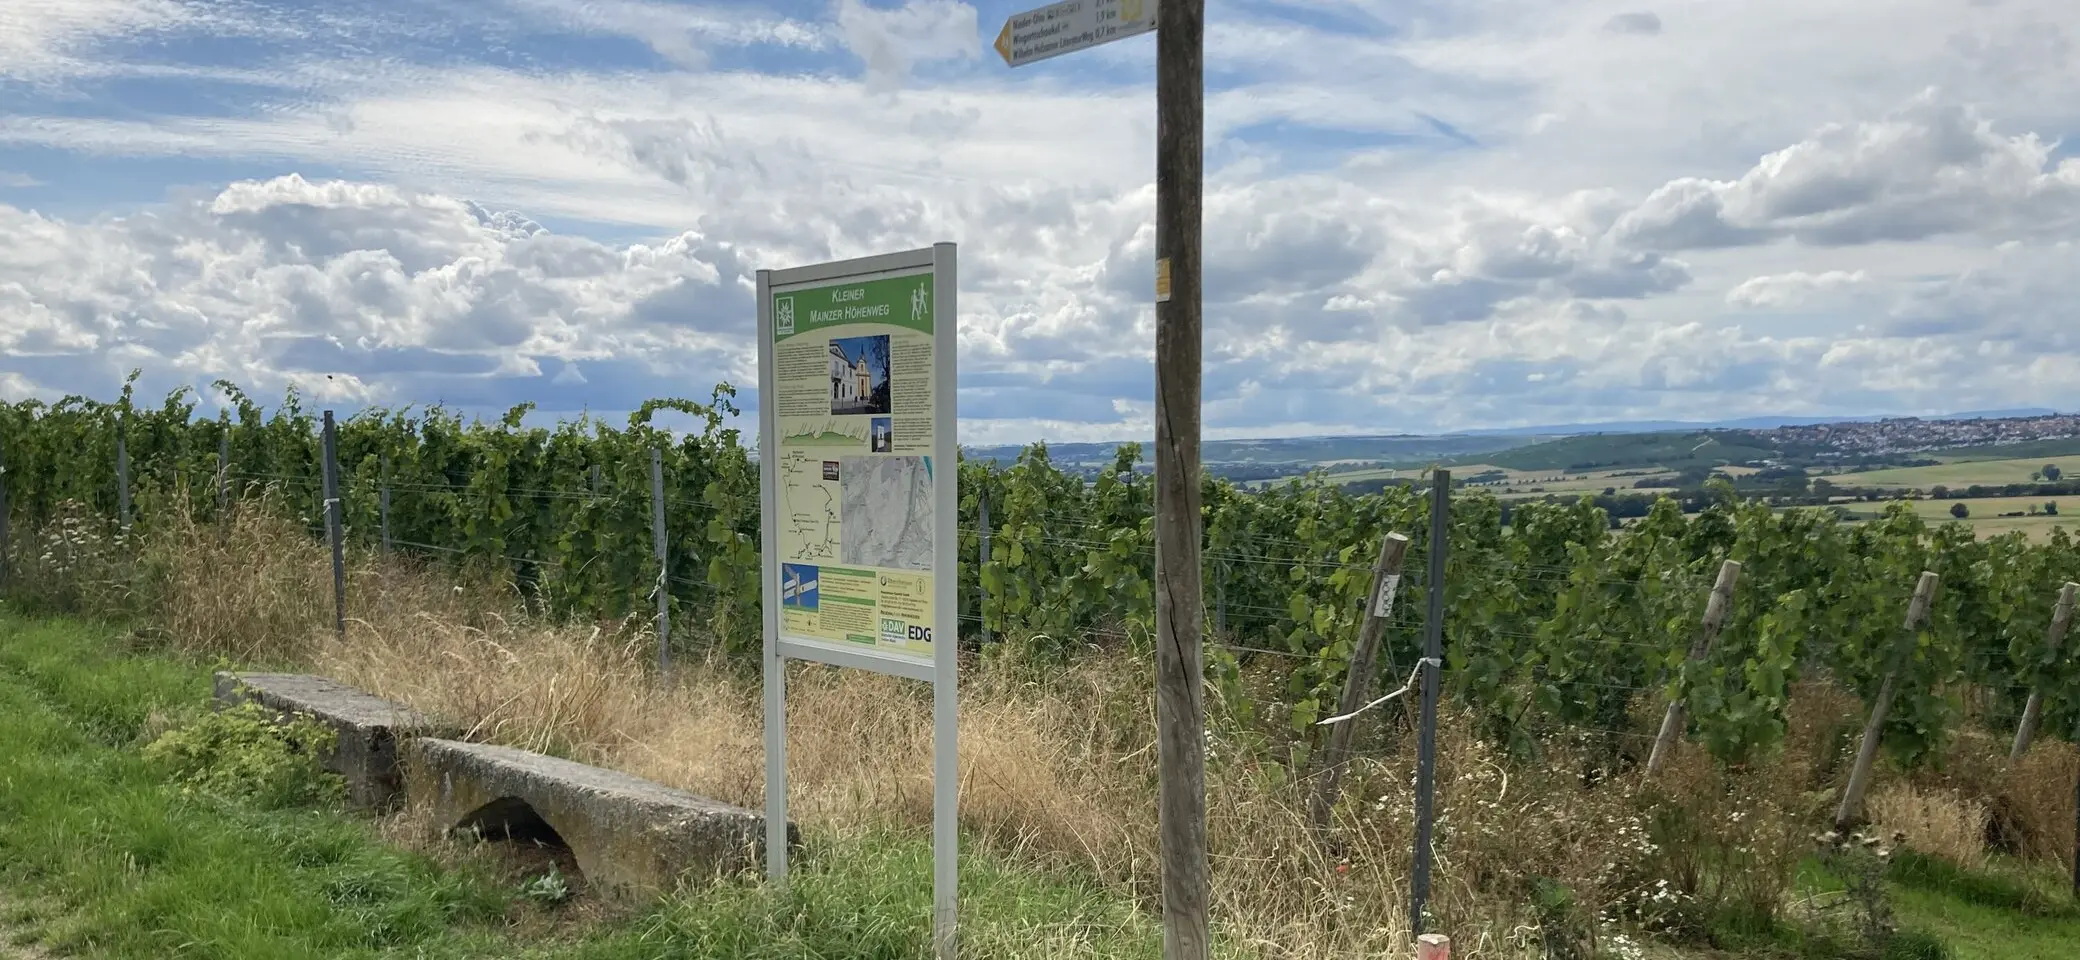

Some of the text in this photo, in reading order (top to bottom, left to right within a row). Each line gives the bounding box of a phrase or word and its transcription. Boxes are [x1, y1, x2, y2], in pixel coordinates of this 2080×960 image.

[832, 288, 865, 303] KLEINER
[810, 304, 890, 323] MAINZER HÖHENWEG
[888, 621, 905, 634] DAV
[908, 625, 932, 643] EDG
